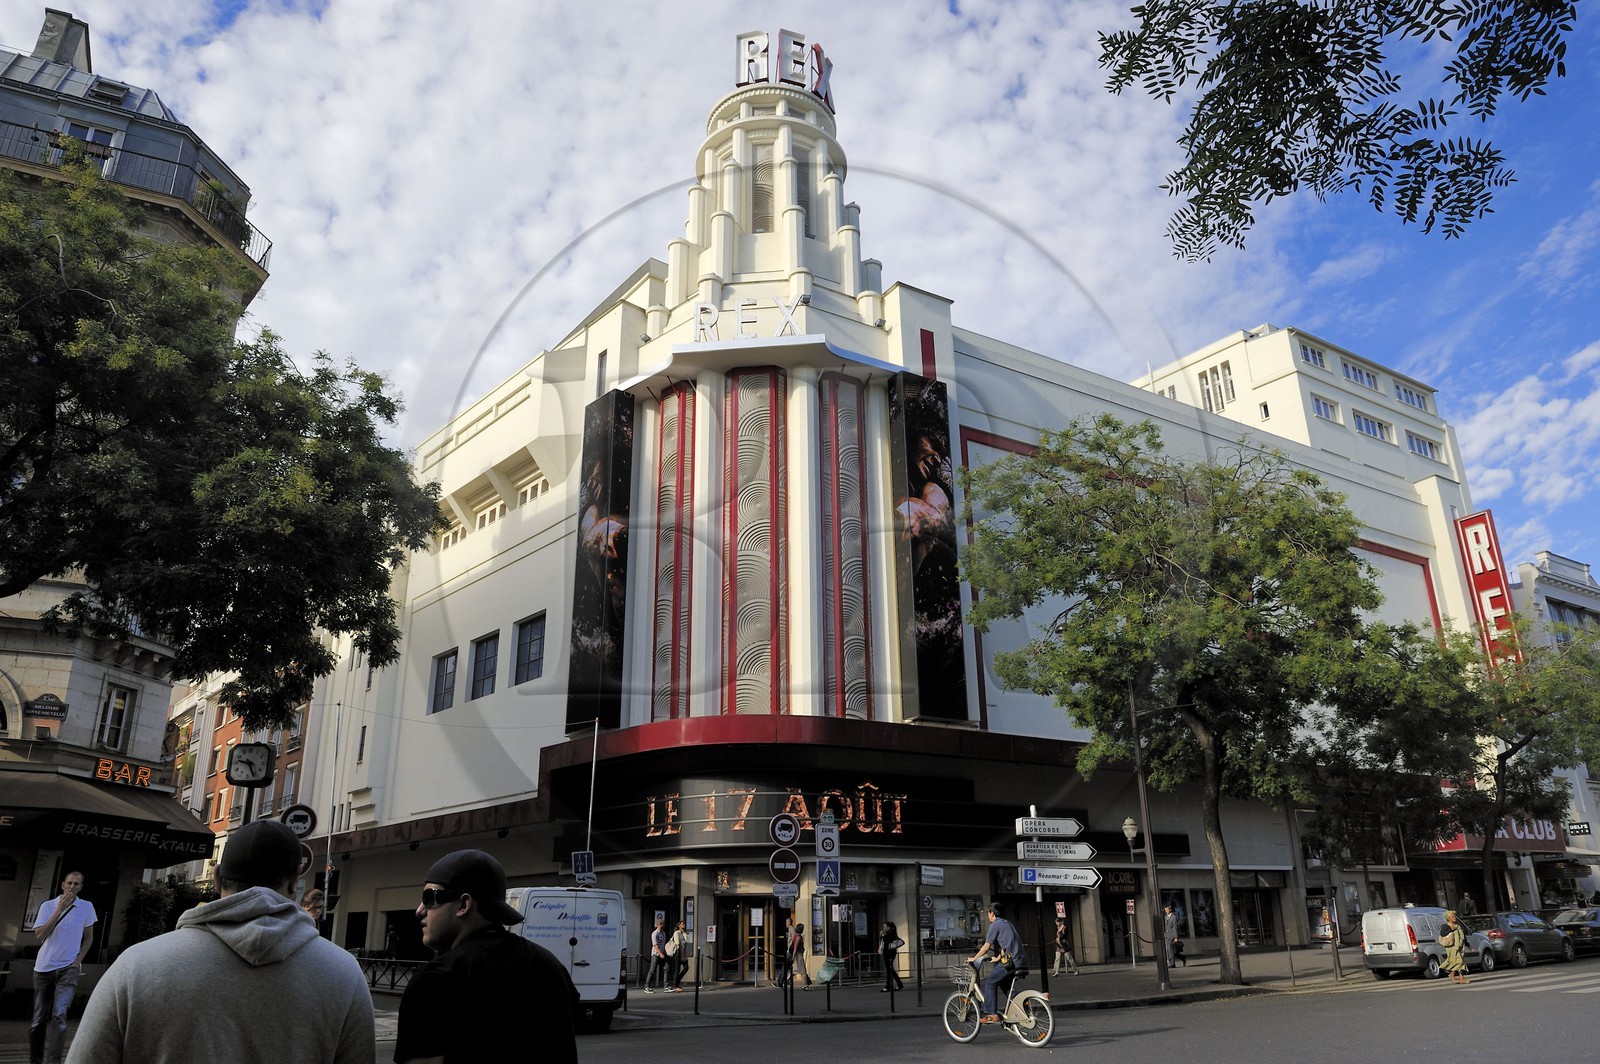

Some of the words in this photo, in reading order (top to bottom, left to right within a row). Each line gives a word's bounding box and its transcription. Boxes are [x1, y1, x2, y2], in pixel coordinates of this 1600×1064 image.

[735, 28, 836, 114] REX
[693, 294, 803, 342] REX
[1464, 522, 1517, 664] RE
[96, 758, 152, 787] BAR
[646, 792, 682, 837] LE
[700, 788, 757, 832] 17
[782, 780, 908, 833] AOÛT
[62, 822, 160, 845] BRASSERIE
[1510, 817, 1556, 841] CLUB
[1027, 871, 1033, 879] P
